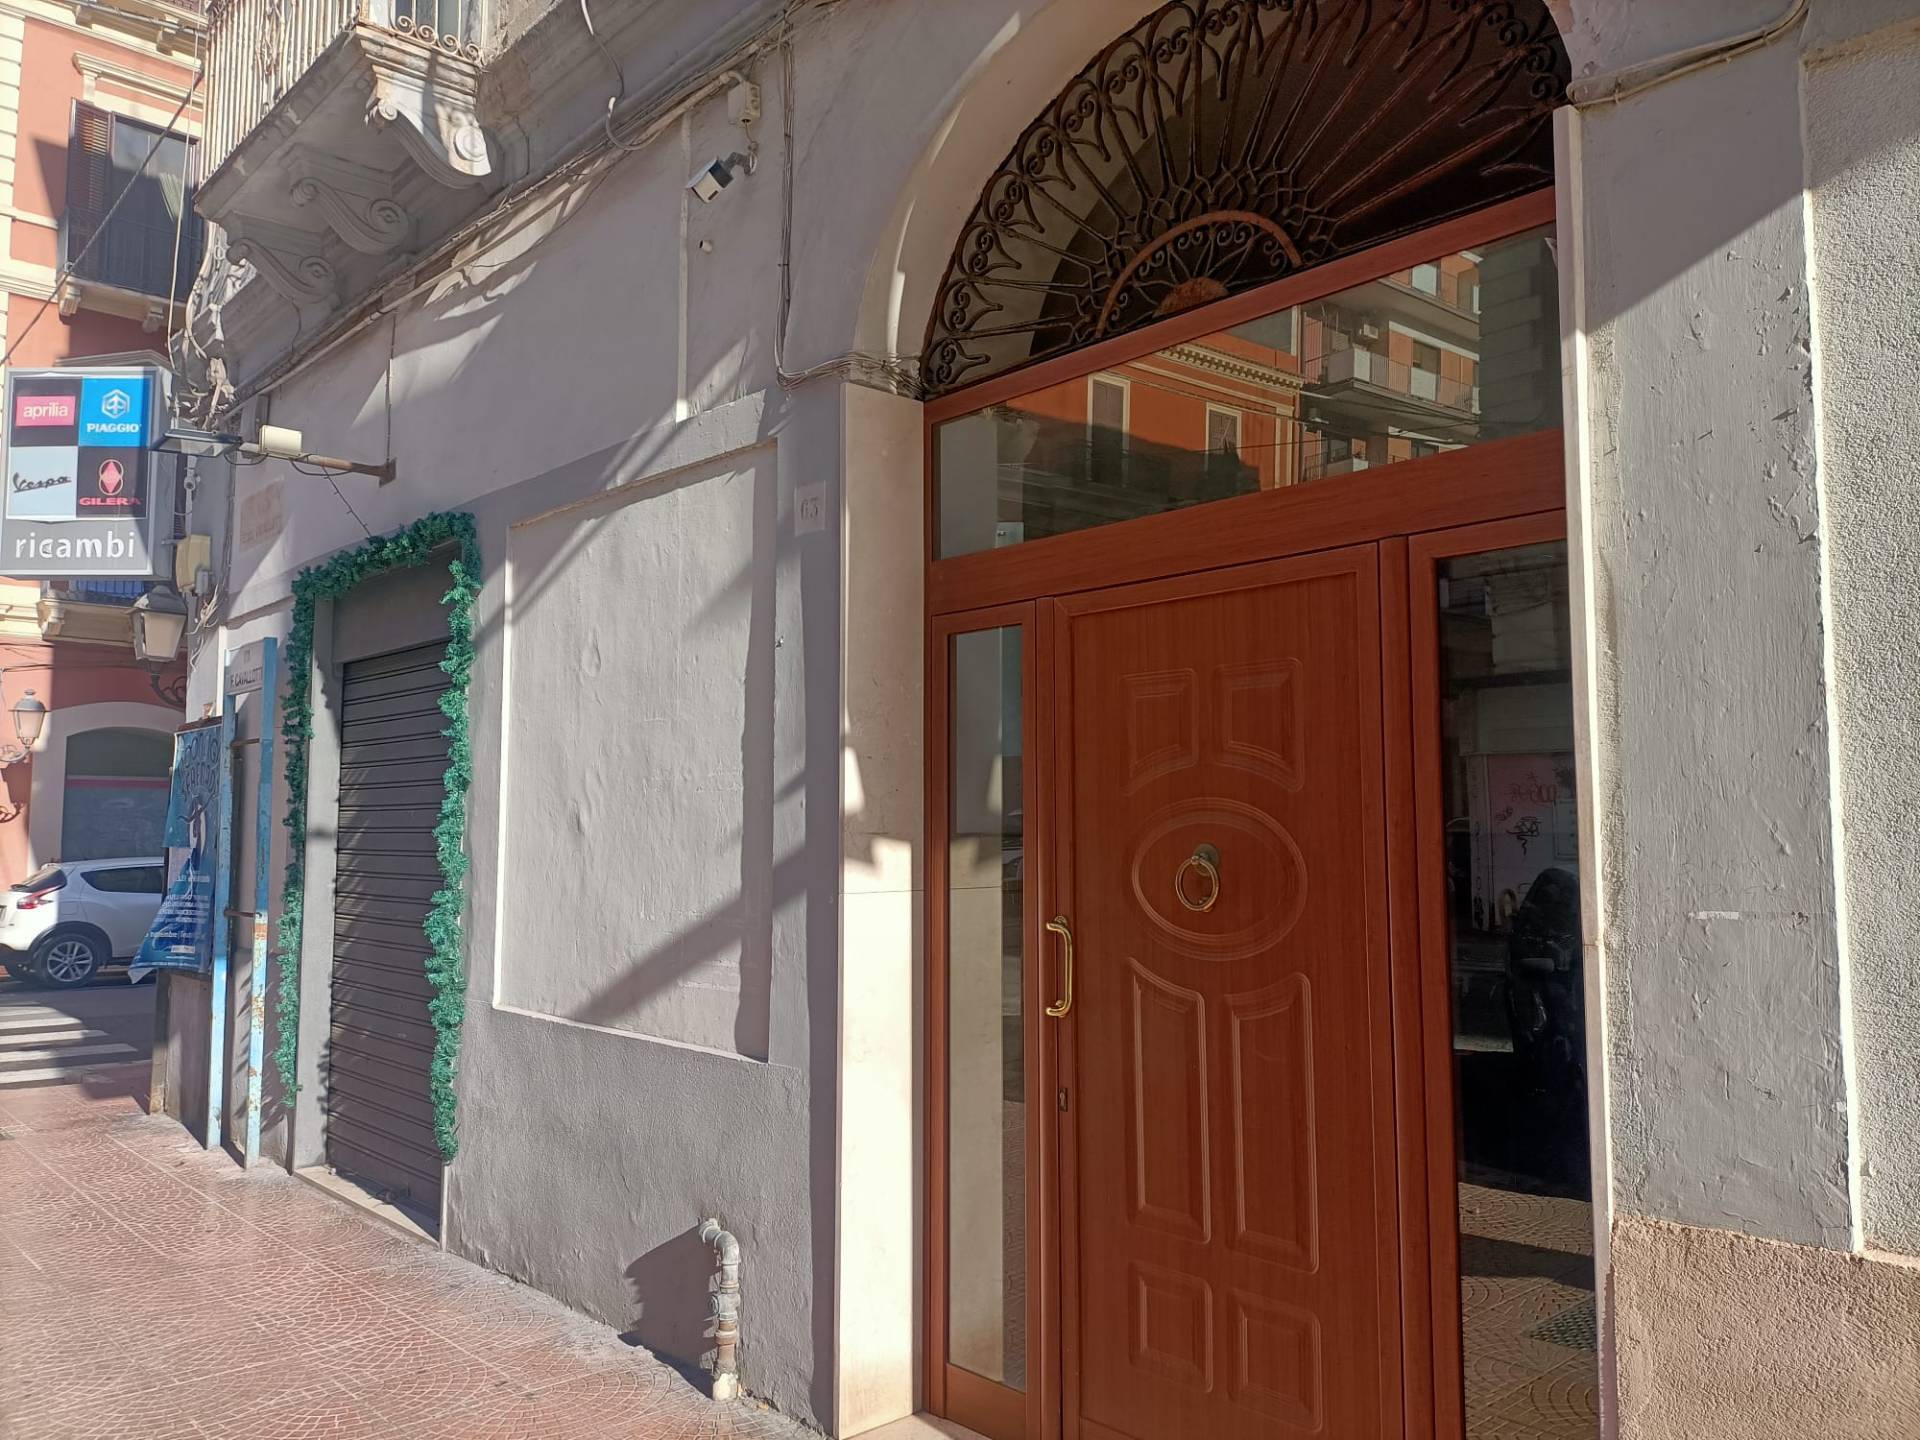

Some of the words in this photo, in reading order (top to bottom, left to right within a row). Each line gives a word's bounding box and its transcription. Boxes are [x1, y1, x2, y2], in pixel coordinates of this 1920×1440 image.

[23, 402, 69, 420] aprilia
[86, 423, 140, 433] PIAGGIO
[12, 472, 72, 493] Vespa
[79, 497, 141, 506] GILERA
[15, 531, 136, 559] ricambi
